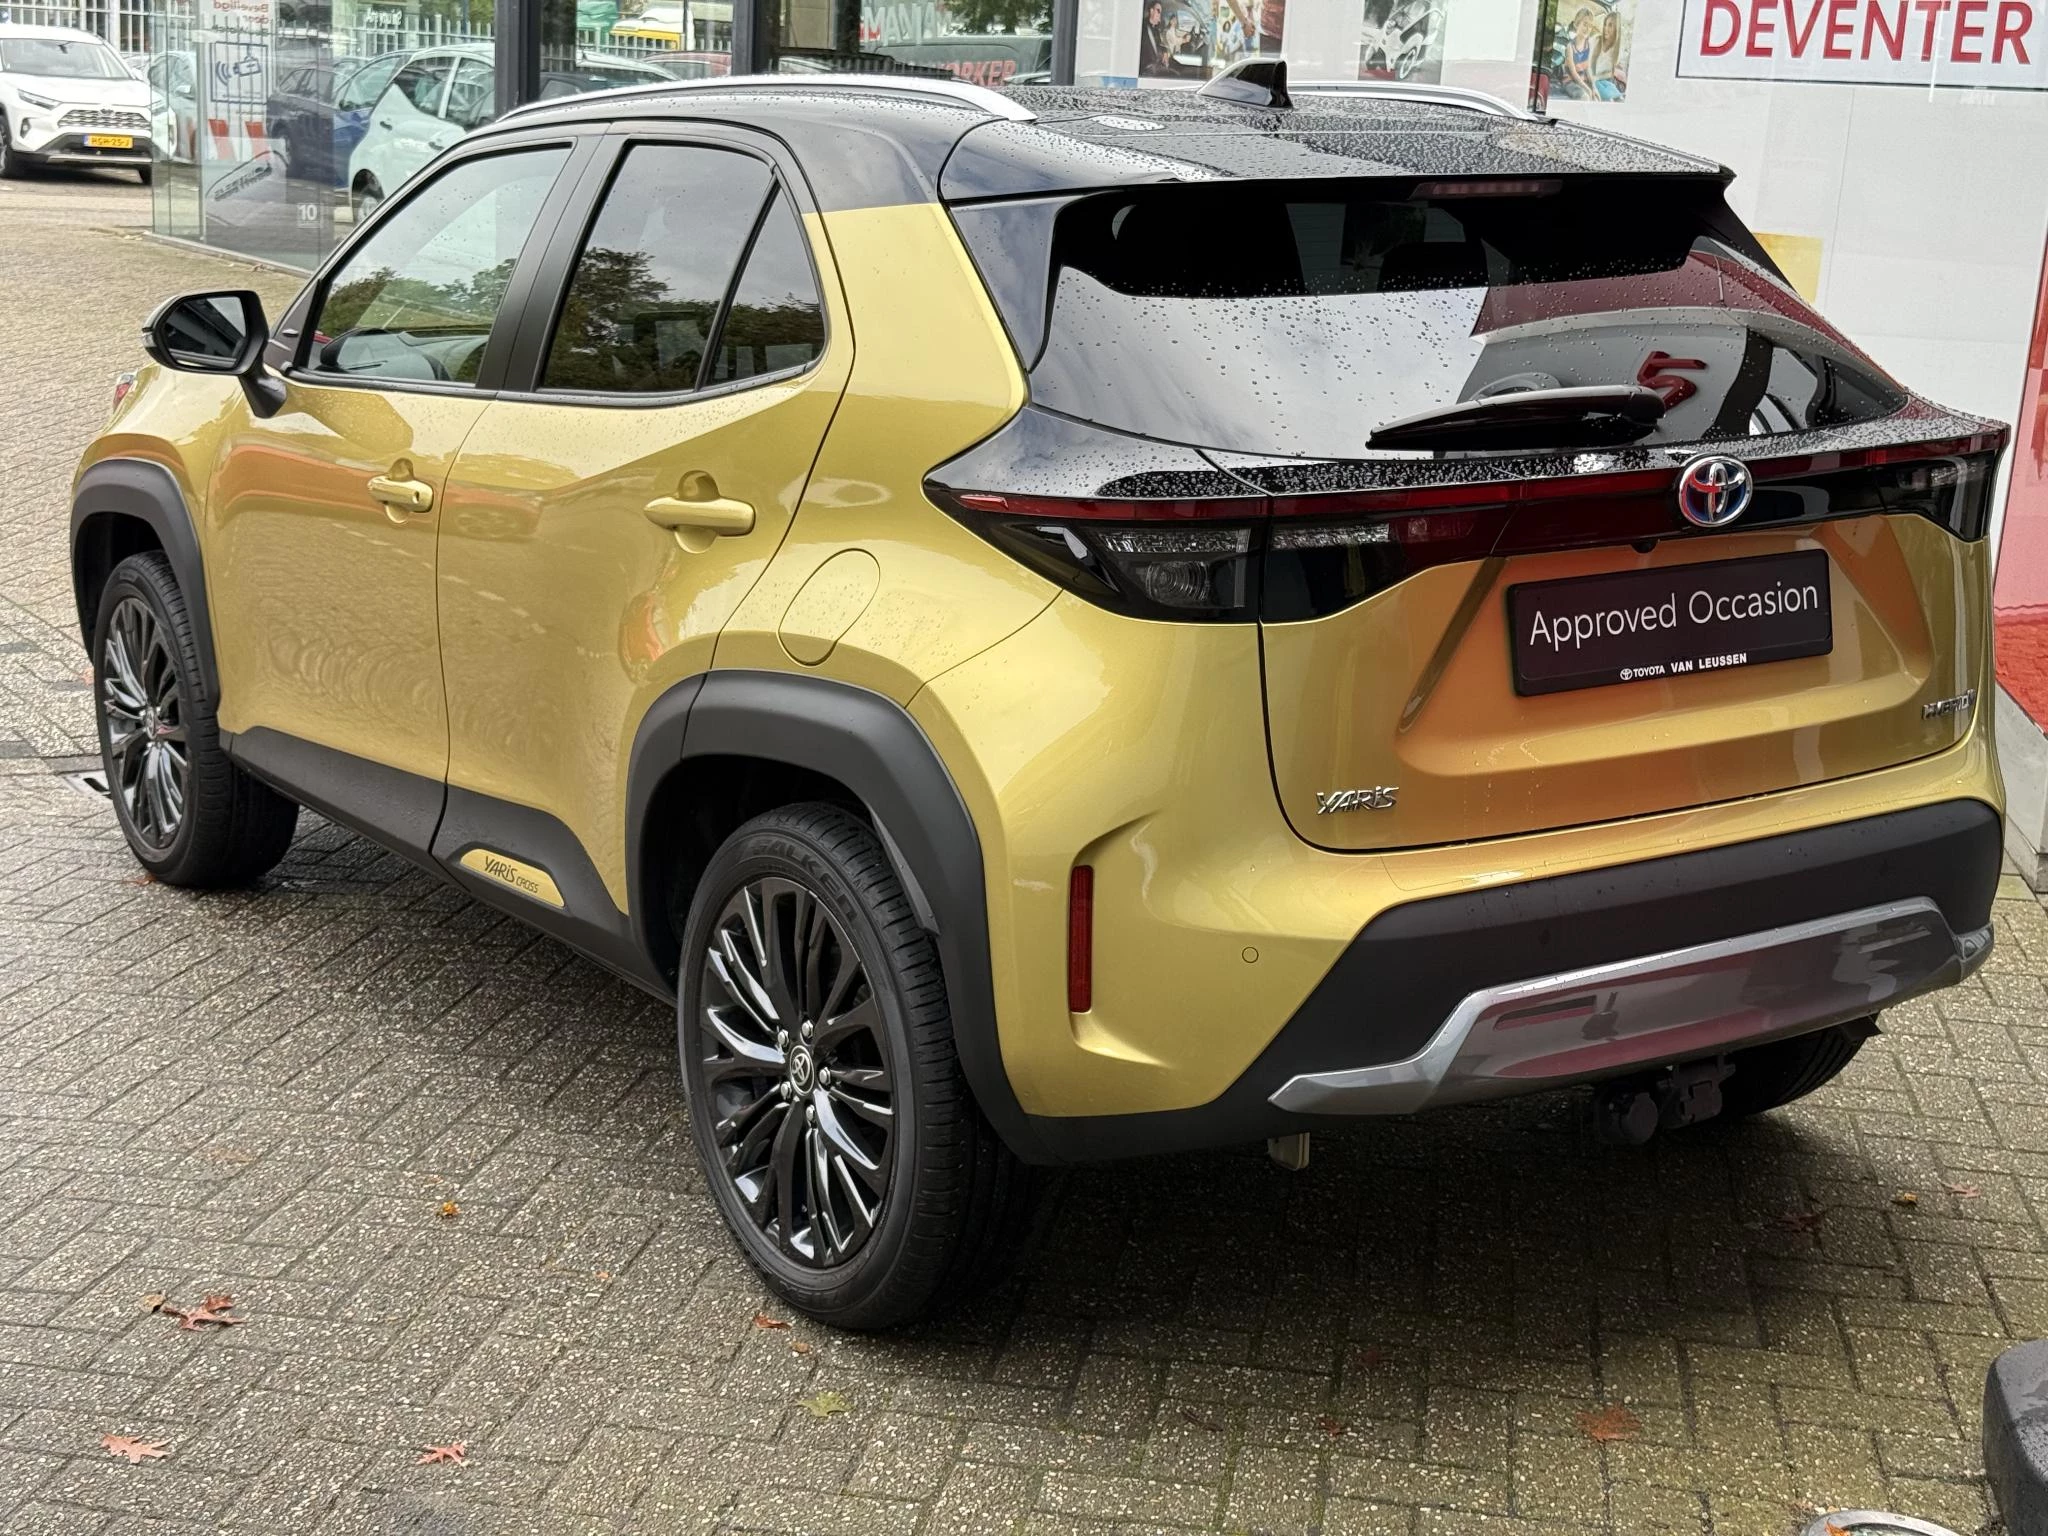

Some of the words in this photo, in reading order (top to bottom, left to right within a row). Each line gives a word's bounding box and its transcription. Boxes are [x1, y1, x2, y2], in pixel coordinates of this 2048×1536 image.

[1699, 0, 2034, 65] DEVENTER
[936, 59, 1017, 86] ORKER
[297, 204, 318, 220] 10
[1529, 592, 1677, 651] Approved
[1688, 581, 1819, 624] Occasion
[1632, 665, 1666, 678] TOYOTA
[1671, 660, 1693, 673] VAN
[1699, 652, 1747, 669] LEUSSEN
[516, 876, 540, 894] CROSS
